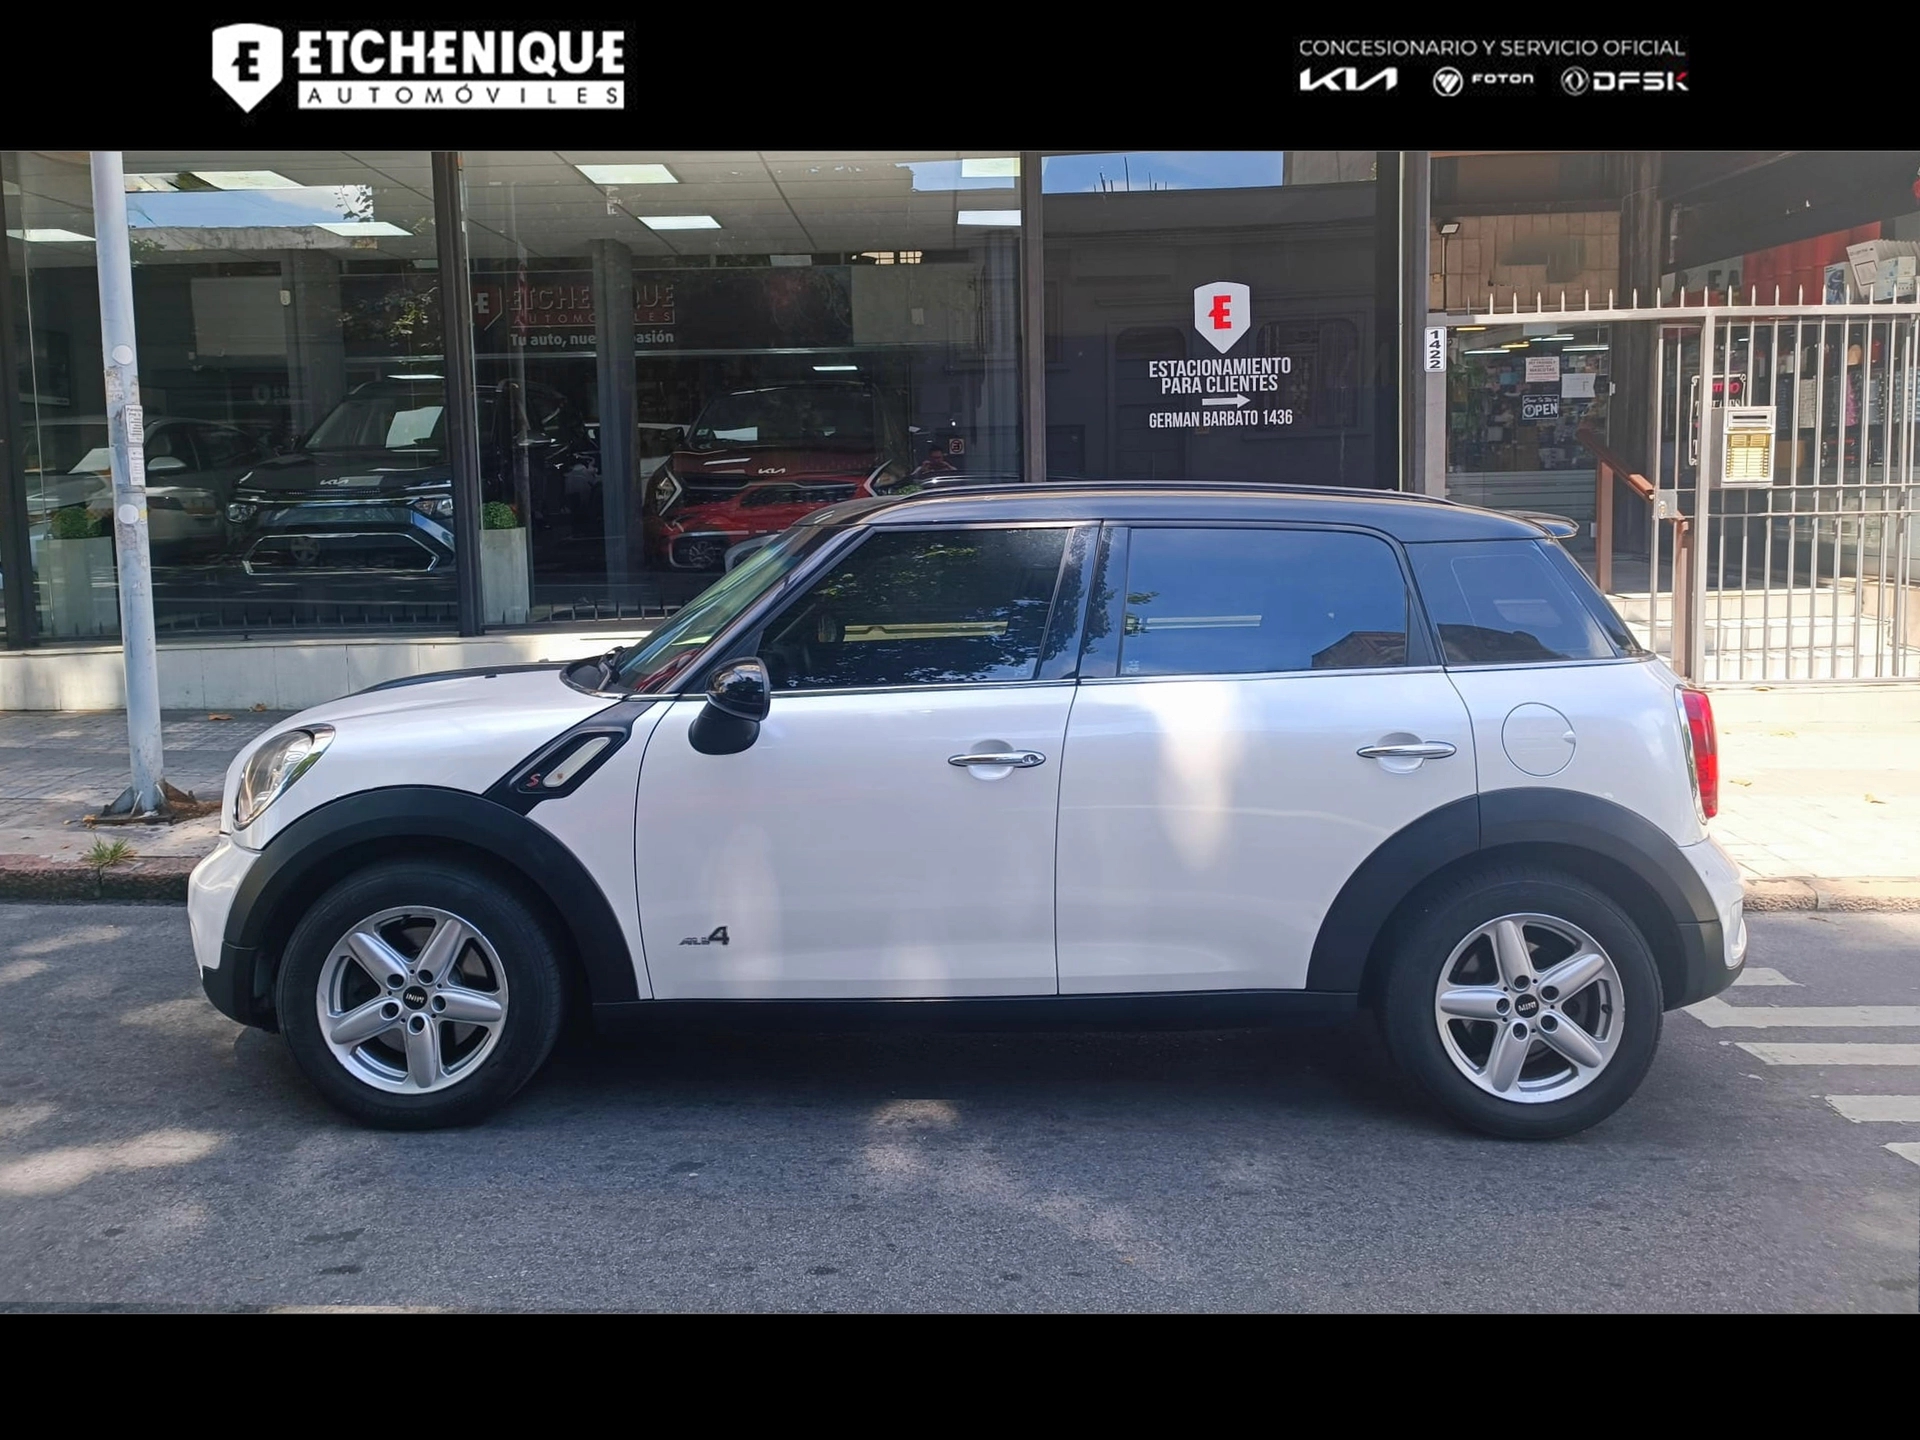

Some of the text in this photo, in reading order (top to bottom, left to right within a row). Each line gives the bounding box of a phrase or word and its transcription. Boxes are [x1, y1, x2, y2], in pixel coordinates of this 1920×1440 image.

[510, 333, 527, 346] Tu
[530, 333, 567, 347] auto,
[633, 330, 675, 343] asión
[1429, 330, 1441, 369] 1422
[1149, 357, 1292, 378] ESTACIONAMIENTO
[1161, 374, 1279, 394] PARA CLIENTES
[1149, 409, 1293, 428] GERMAN BARBATO 1436
[1523, 403, 1558, 418] OPEN
[526, 773, 541, 787] S
